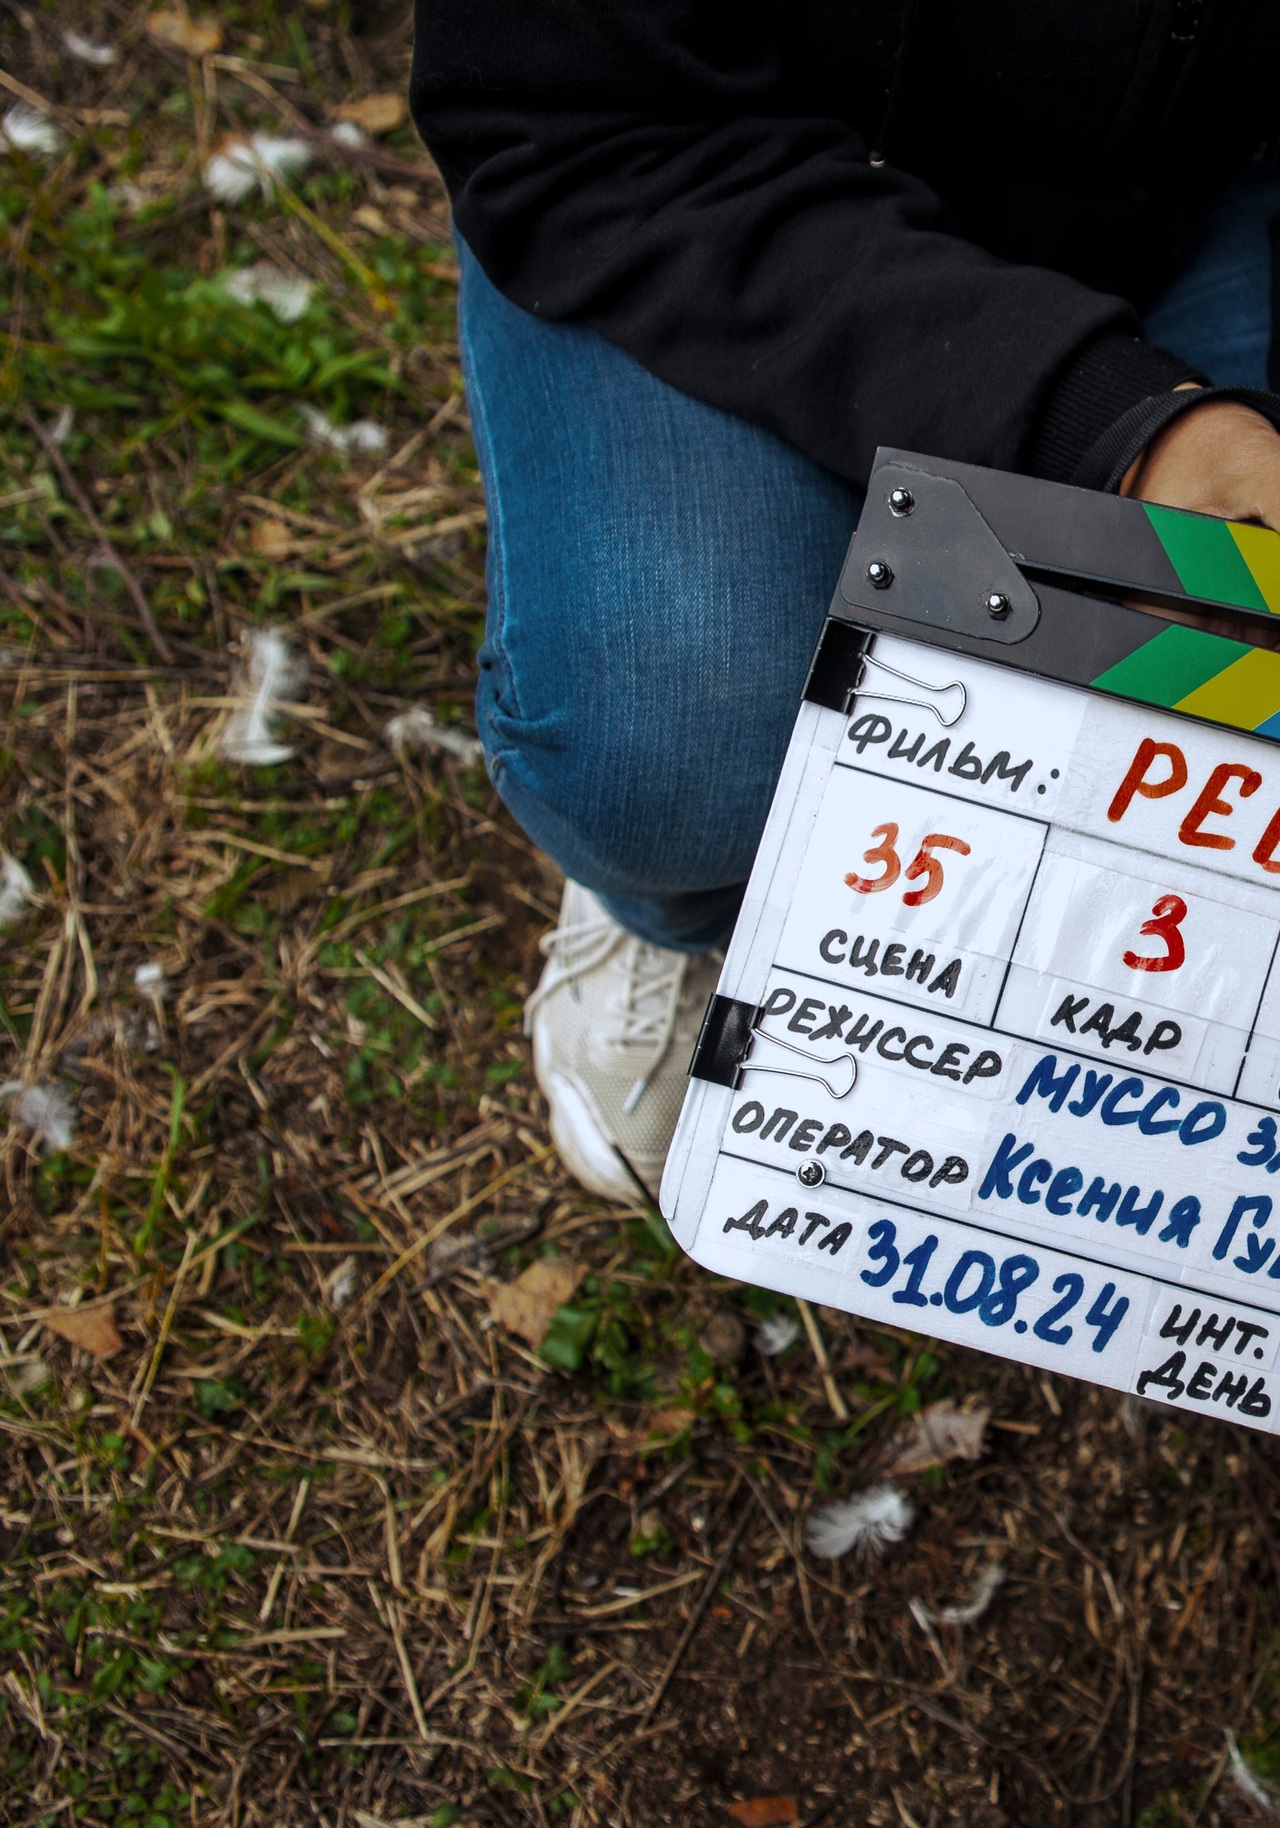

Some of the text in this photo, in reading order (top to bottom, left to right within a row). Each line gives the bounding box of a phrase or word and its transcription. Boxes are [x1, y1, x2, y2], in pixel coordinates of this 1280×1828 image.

[844, 822, 971, 907] 35
[819, 928, 963, 999] СЦЕНА
[1122, 893, 1187, 973] 3
[1051, 994, 1183, 1055] КАДР
[762, 988, 1003, 1085] РЕЖИССЕР
[1015, 1054, 1228, 1146] МУССО
[732, 1100, 970, 1188] ОПЕРАТОР
[723, 1199, 1130, 1354] ДАТА 31.08.24
[1159, 1304, 1269, 1360] ИНТ.
[1137, 1351, 1272, 1418] ДЕНЬ
